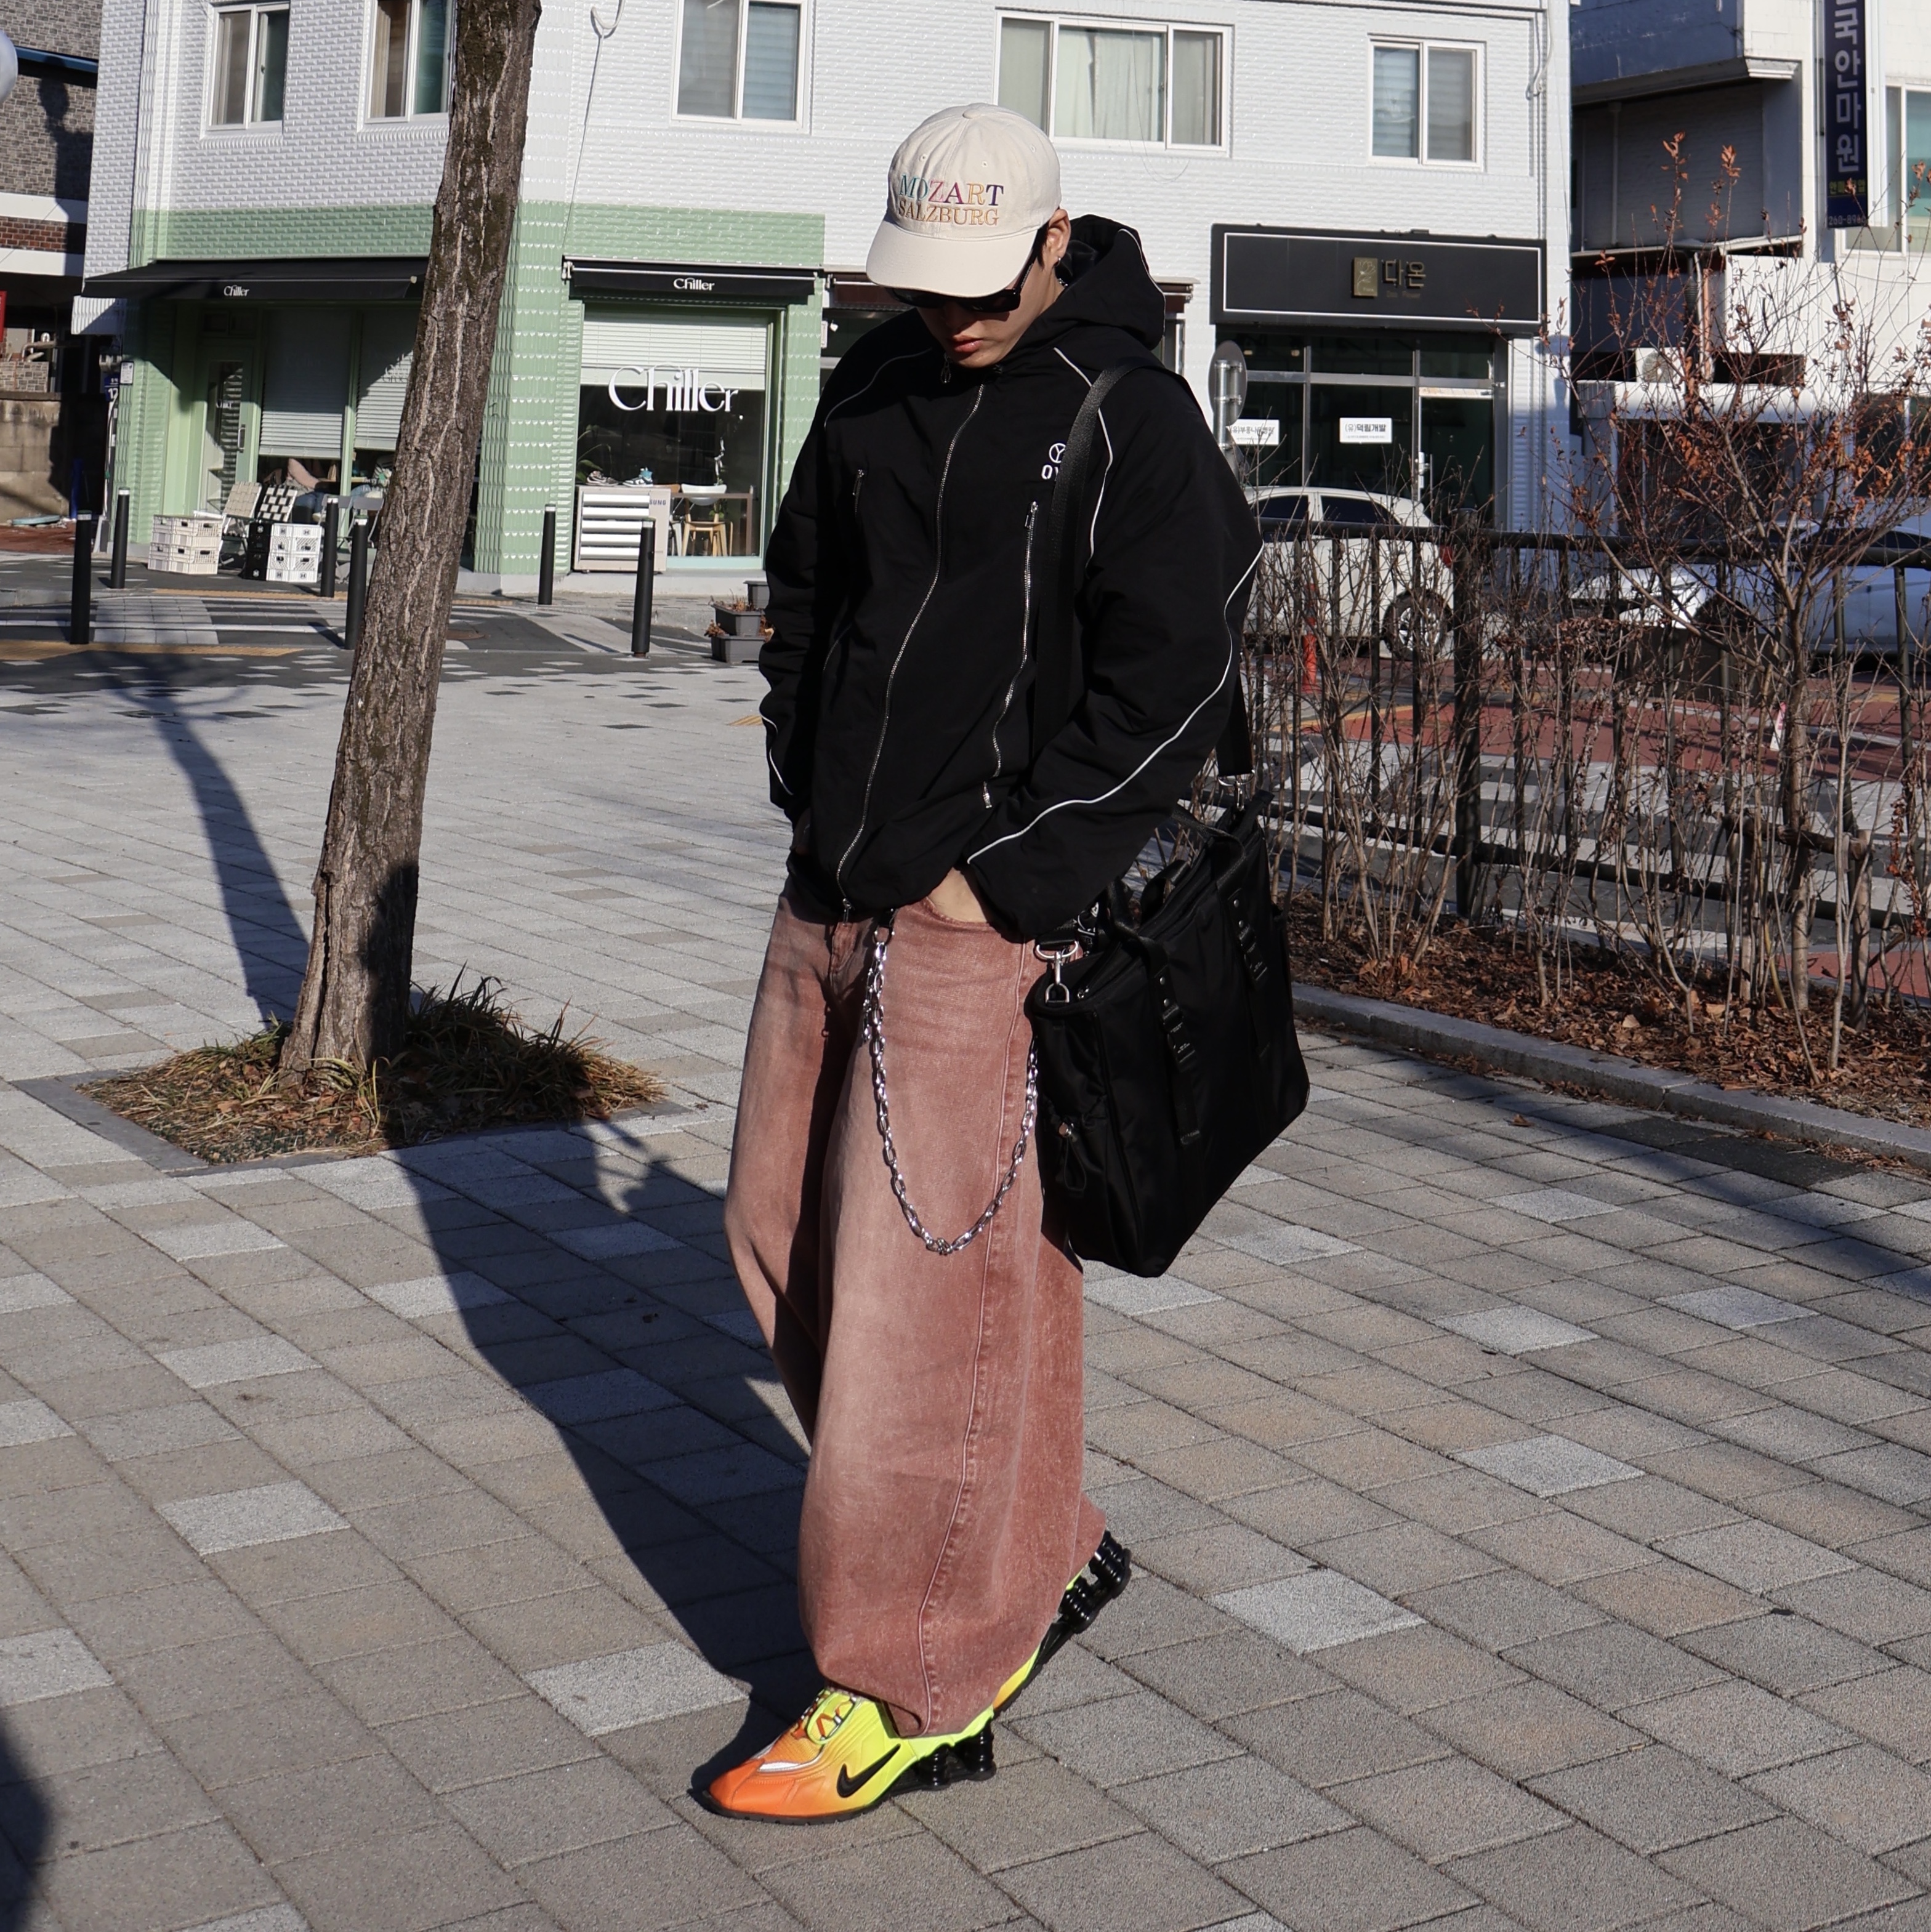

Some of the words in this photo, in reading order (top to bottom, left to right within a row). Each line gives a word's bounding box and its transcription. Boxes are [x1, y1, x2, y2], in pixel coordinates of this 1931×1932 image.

[1834, 0, 1861, 172] 국안마원
[898, 174, 1004, 206] MOZART
[898, 198, 999, 226] SALZBURG
[673, 277, 716, 291] Chiller
[1385, 259, 1426, 287] 다온
[224, 284, 250, 296] Chiller
[608, 362, 739, 412] Chiller
